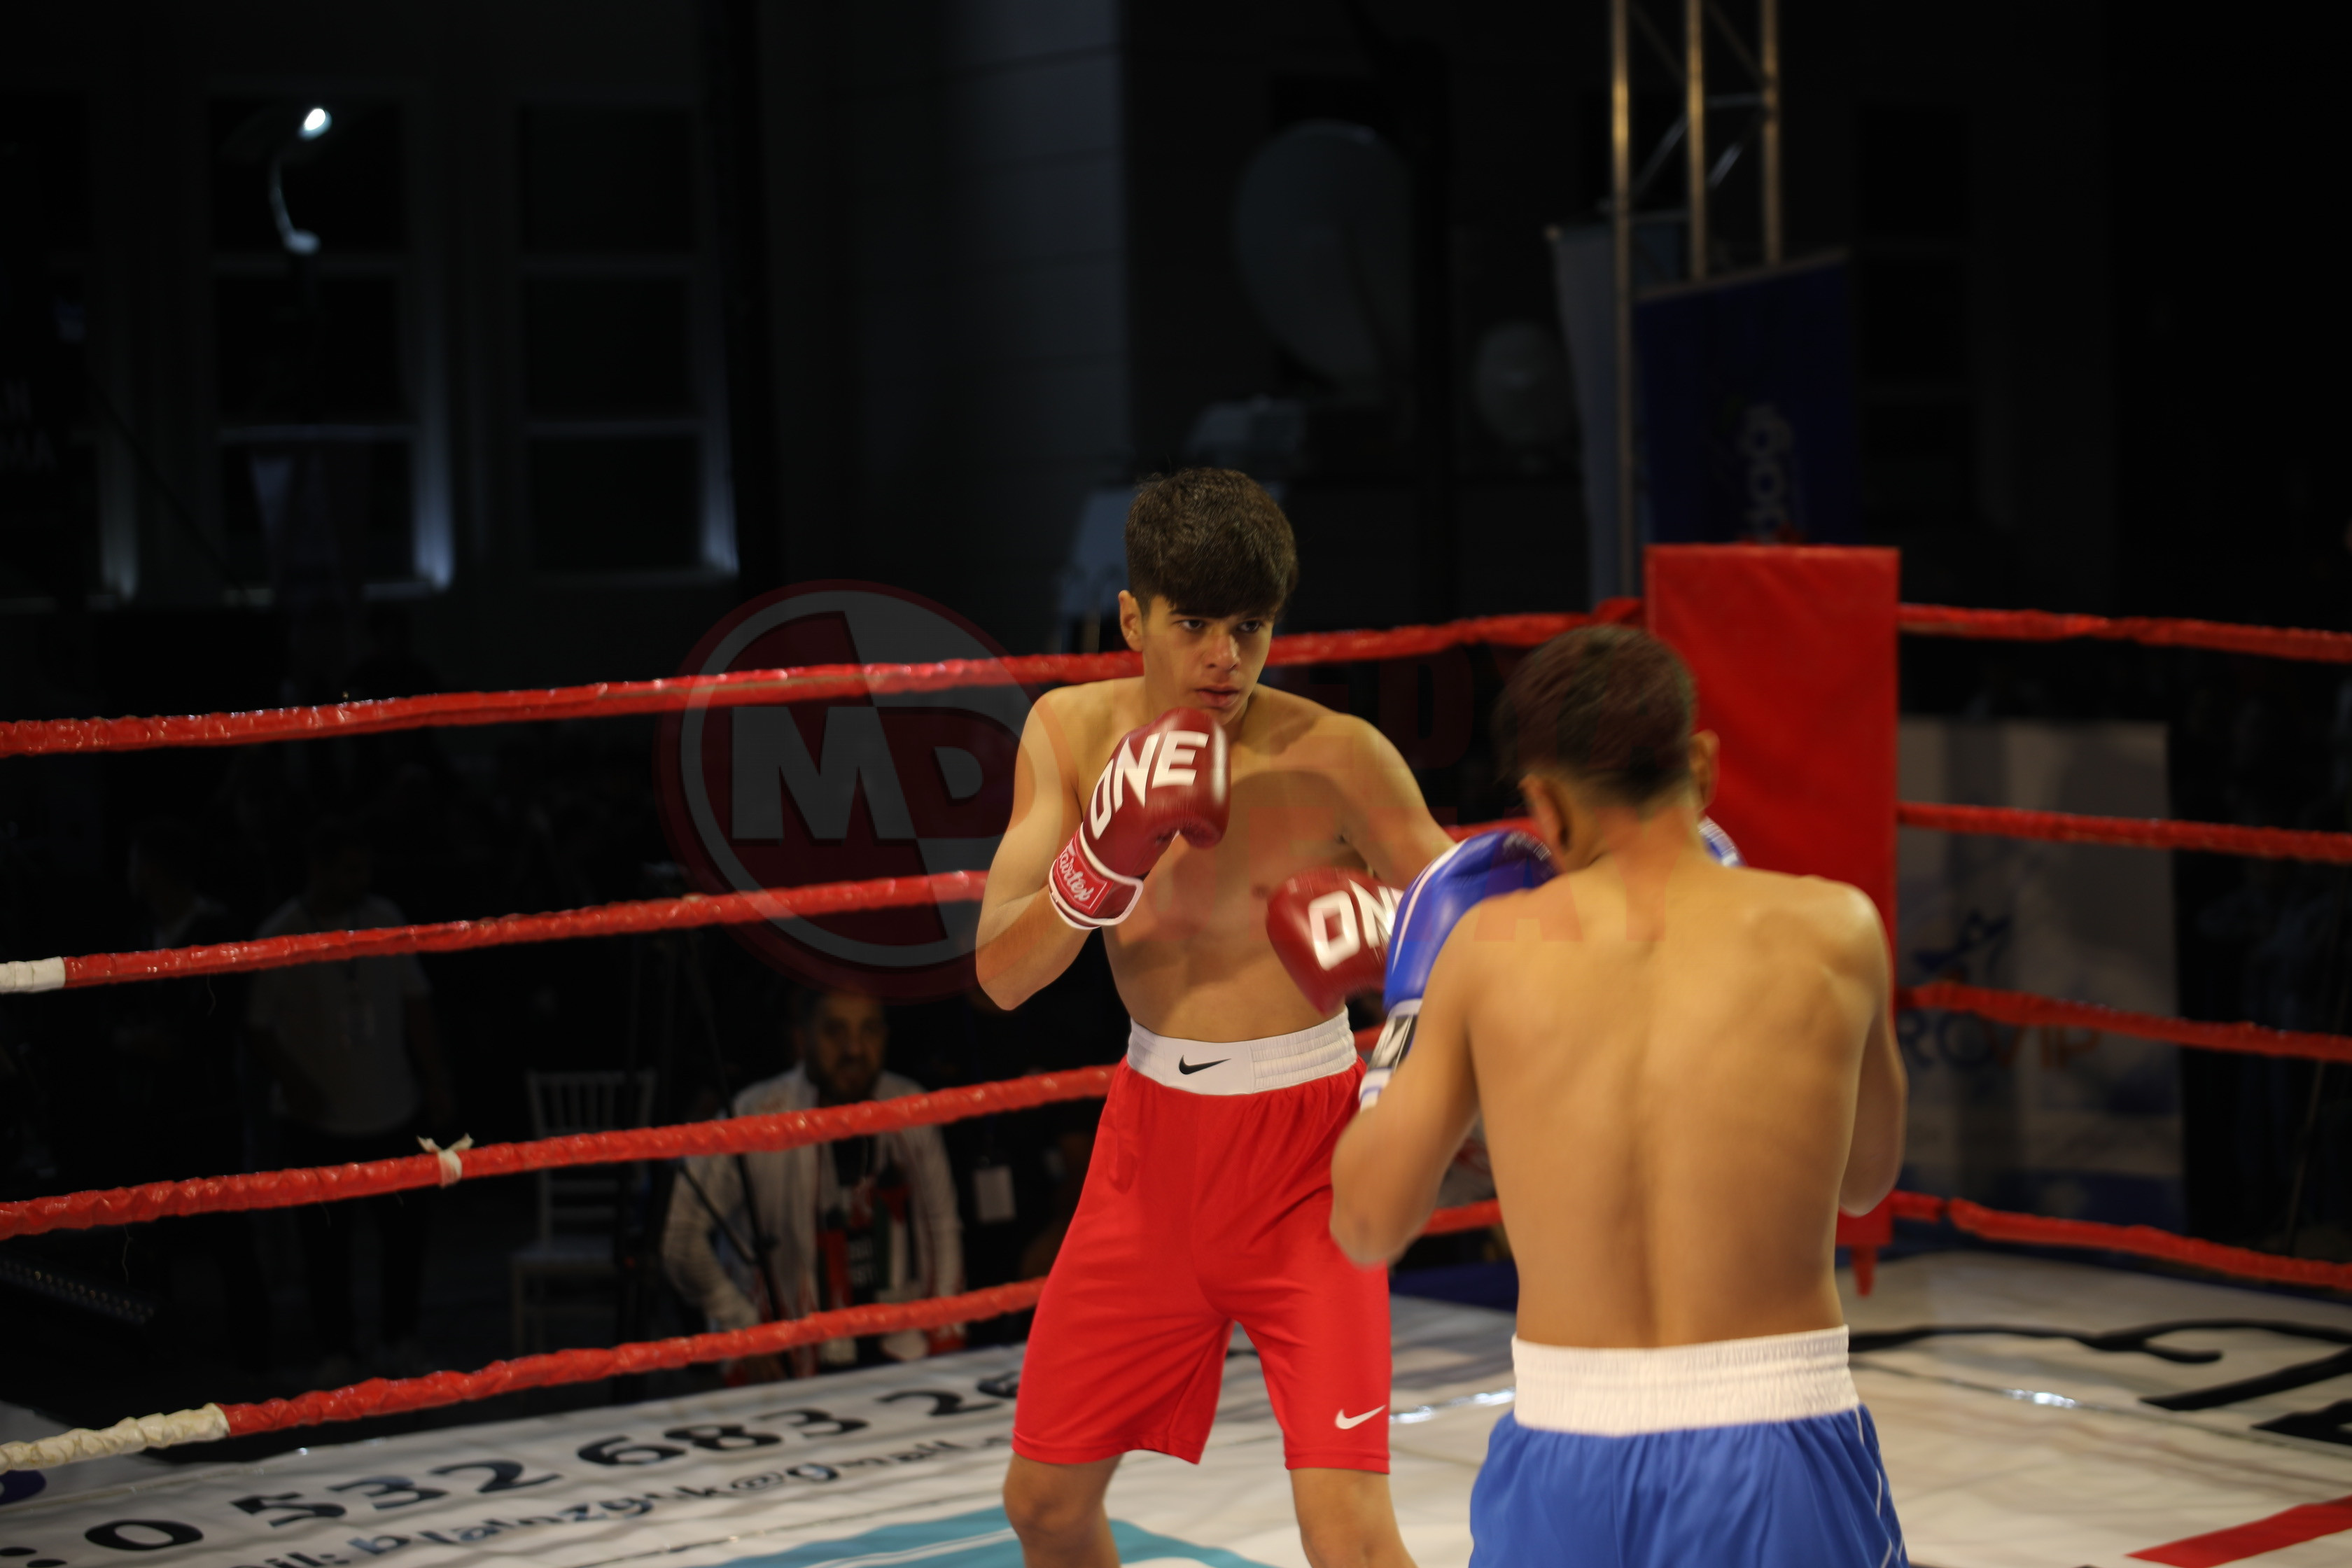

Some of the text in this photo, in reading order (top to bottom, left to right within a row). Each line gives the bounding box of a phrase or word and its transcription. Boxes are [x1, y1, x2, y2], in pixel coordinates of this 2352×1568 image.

[1090, 730, 1210, 840] ONE
[1307, 878, 1404, 972] ON
[230, 1460, 564, 1528] 532
[578, 1407, 869, 1465] 683
